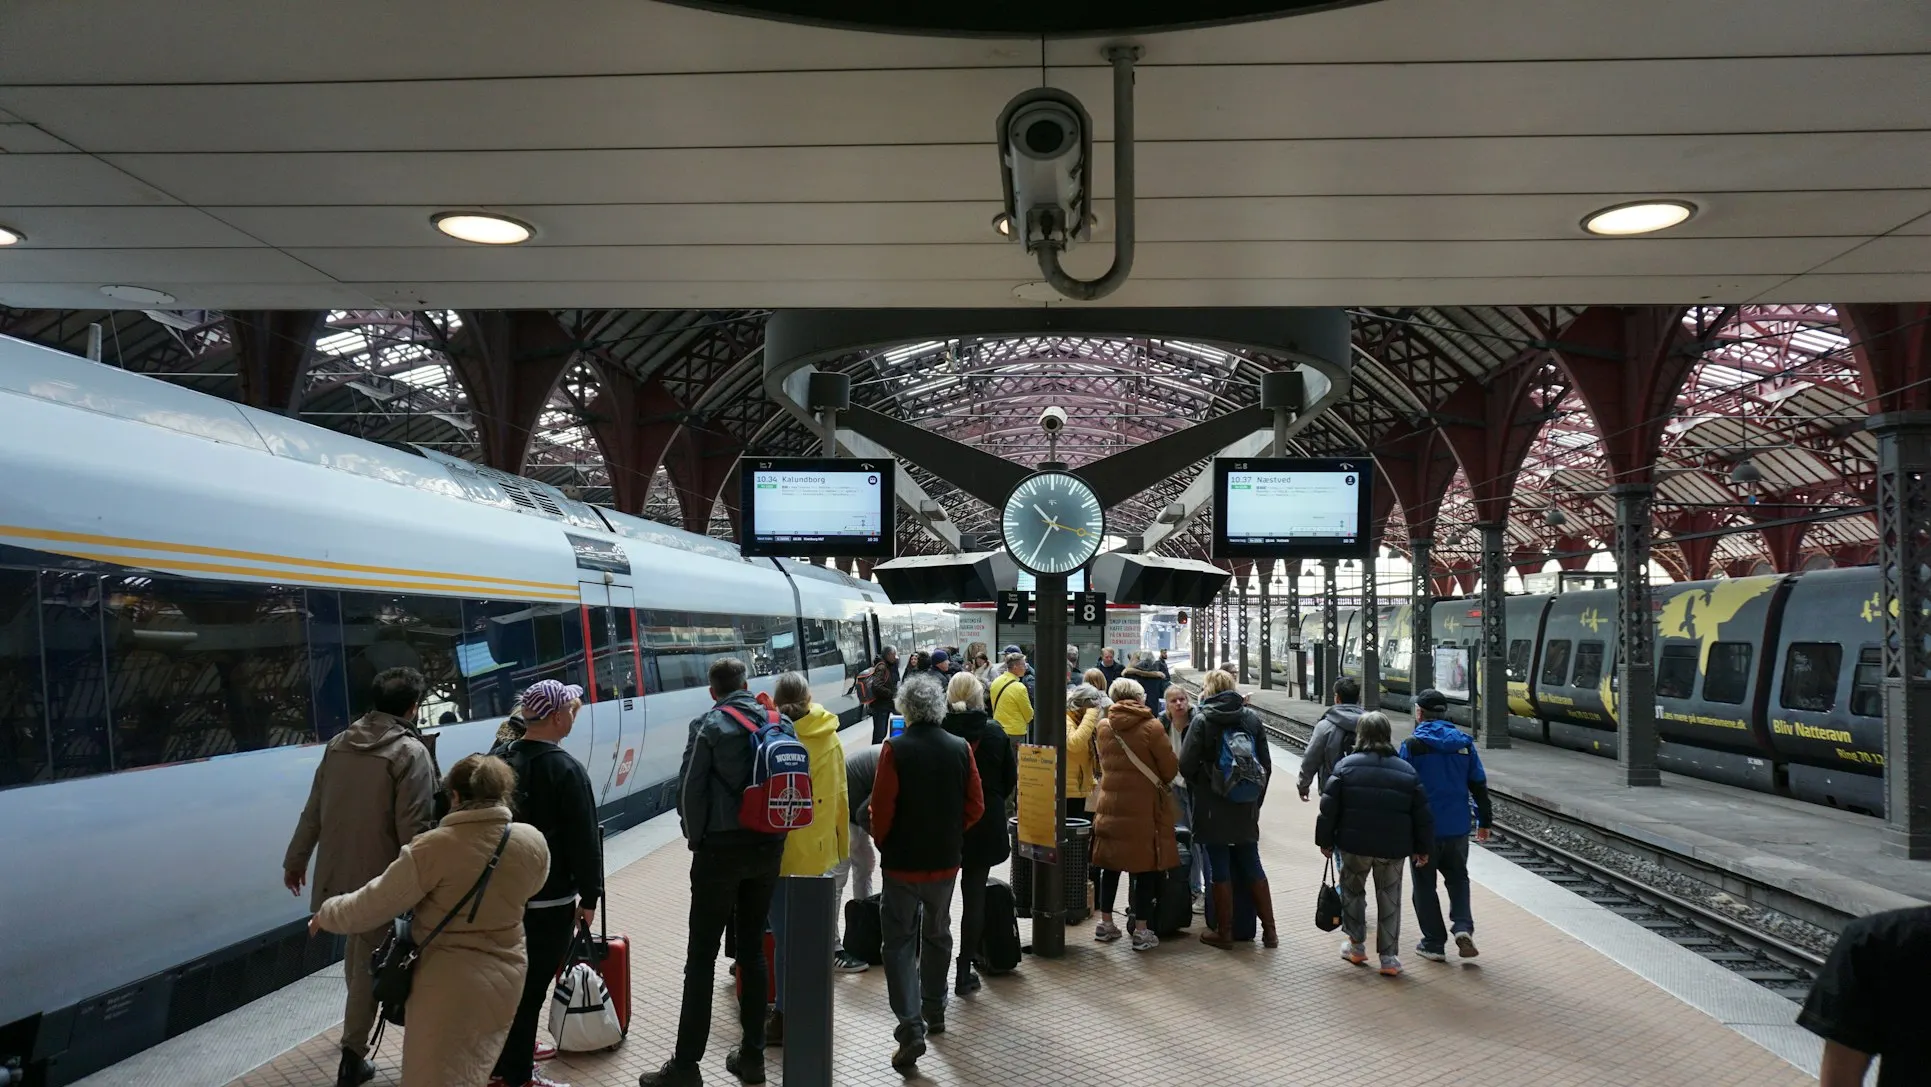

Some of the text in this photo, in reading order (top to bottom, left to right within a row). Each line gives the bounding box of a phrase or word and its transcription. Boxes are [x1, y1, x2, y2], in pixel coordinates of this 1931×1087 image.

[767, 461, 773, 469] 7
[1242, 462, 1248, 470] 8
[756, 475, 826, 484] 10.34 Kalundborg
[1006, 603, 1019, 620] 7
[1083, 604, 1096, 621] 8
[1772, 719, 1852, 743] Bliv Natteravn
[775, 752, 807, 763] NORWAY
[1835, 747, 1858, 763] Ring
[1857, 750, 1872, 764] 70
[618, 760, 633, 775] DSB
